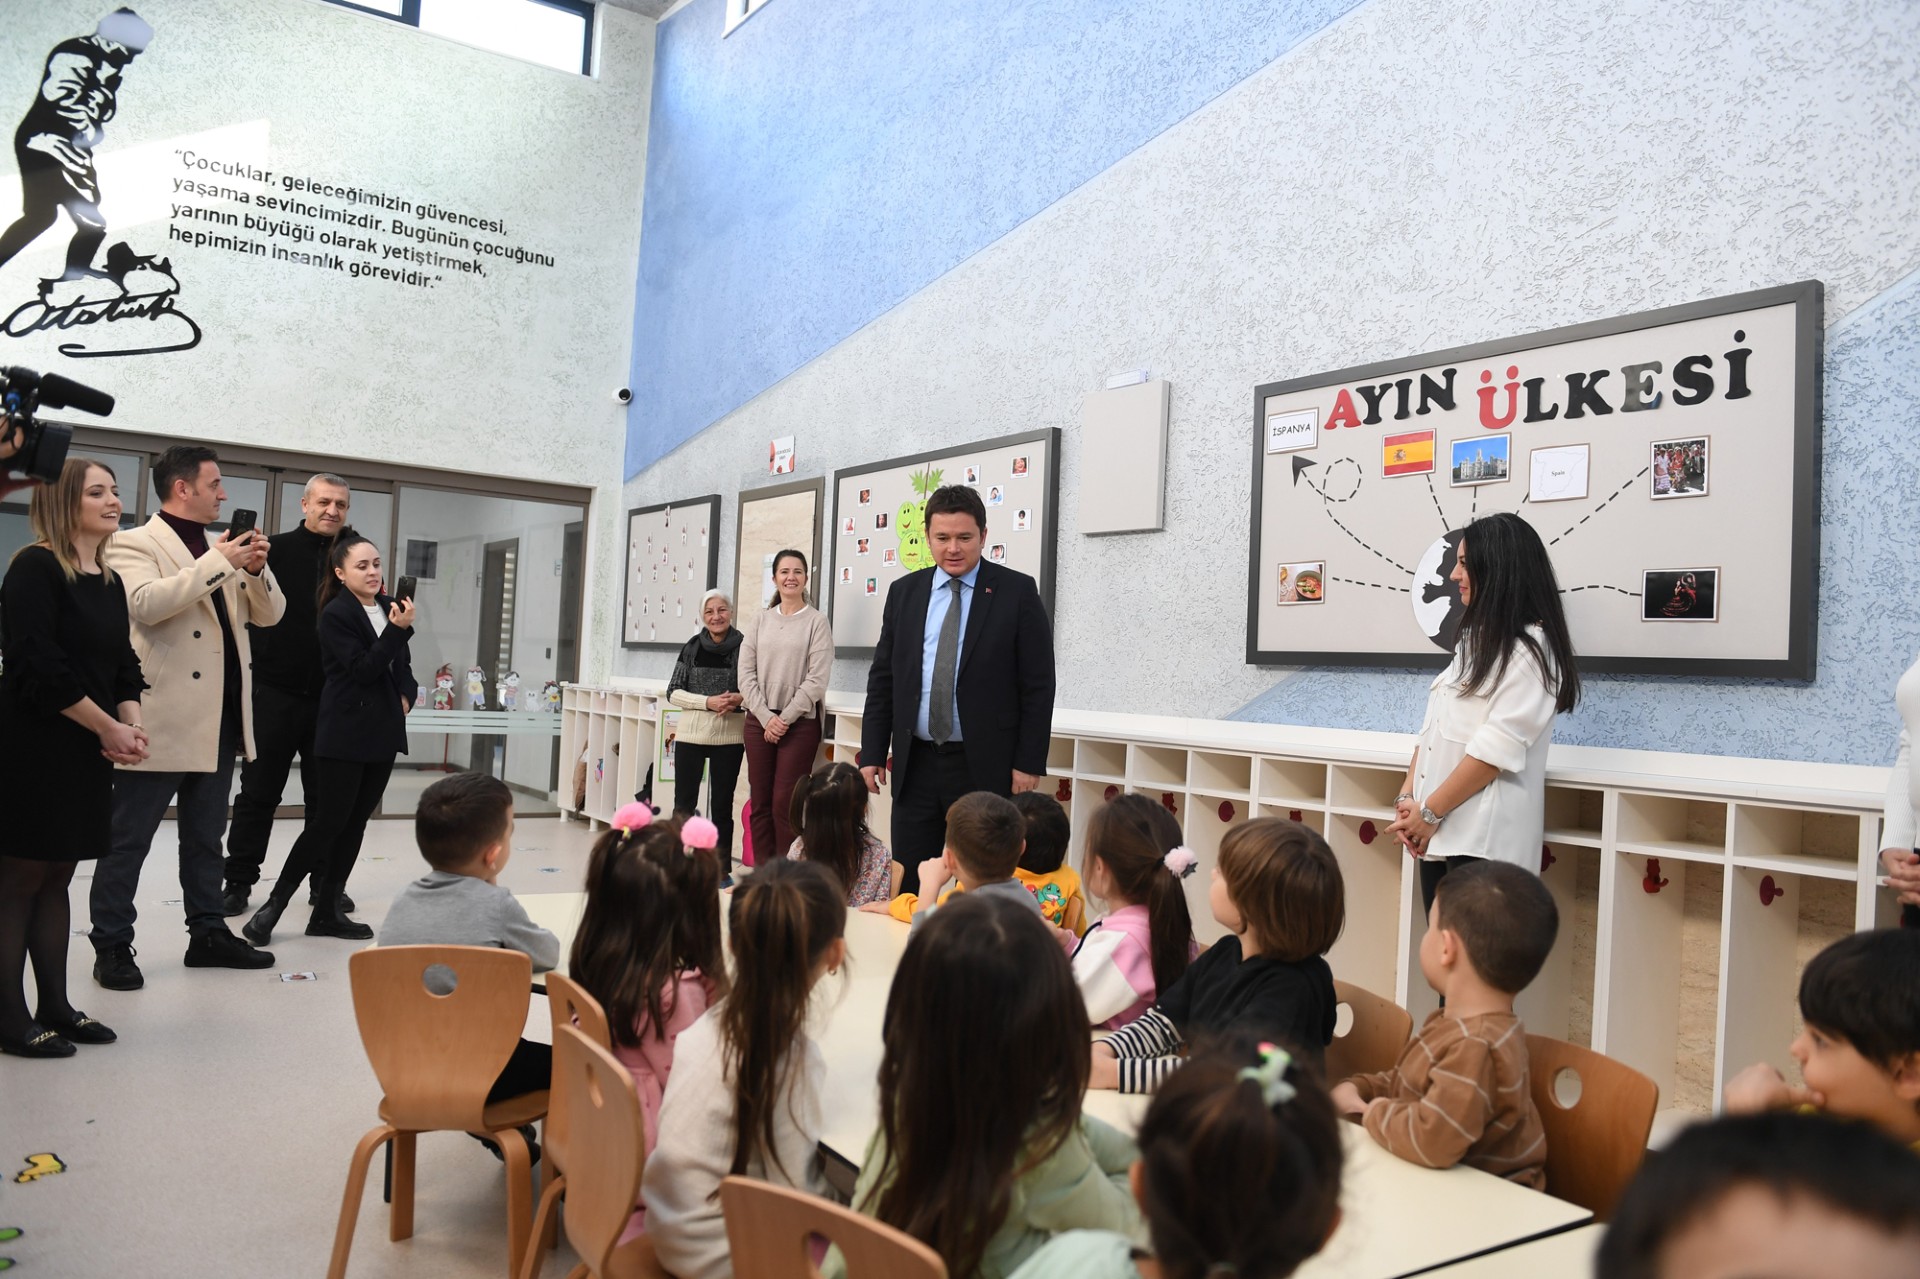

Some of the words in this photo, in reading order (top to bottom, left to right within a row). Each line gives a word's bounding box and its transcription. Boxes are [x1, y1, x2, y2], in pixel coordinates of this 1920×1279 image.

[173, 177, 250, 204] yaşama
[255, 195, 386, 232] sevincimizdir.
[392, 219, 469, 249] Bugünün
[473, 241, 555, 268] çocuğunu
[282, 175, 411, 213] geleceğimizin
[416, 203, 507, 236] güvencesi,
[169, 224, 266, 257] hepimizin
[272, 243, 344, 271] insanlık
[170, 203, 238, 227] yarının
[244, 213, 314, 242] büyüğü
[319, 231, 377, 254] olarak
[382, 244, 487, 278] yetiştirmek,
[1324, 368, 1457, 430] AYIN
[1476, 329, 1753, 430] ÜLKESİ
[1272, 423, 1311, 437] İSPANYA
